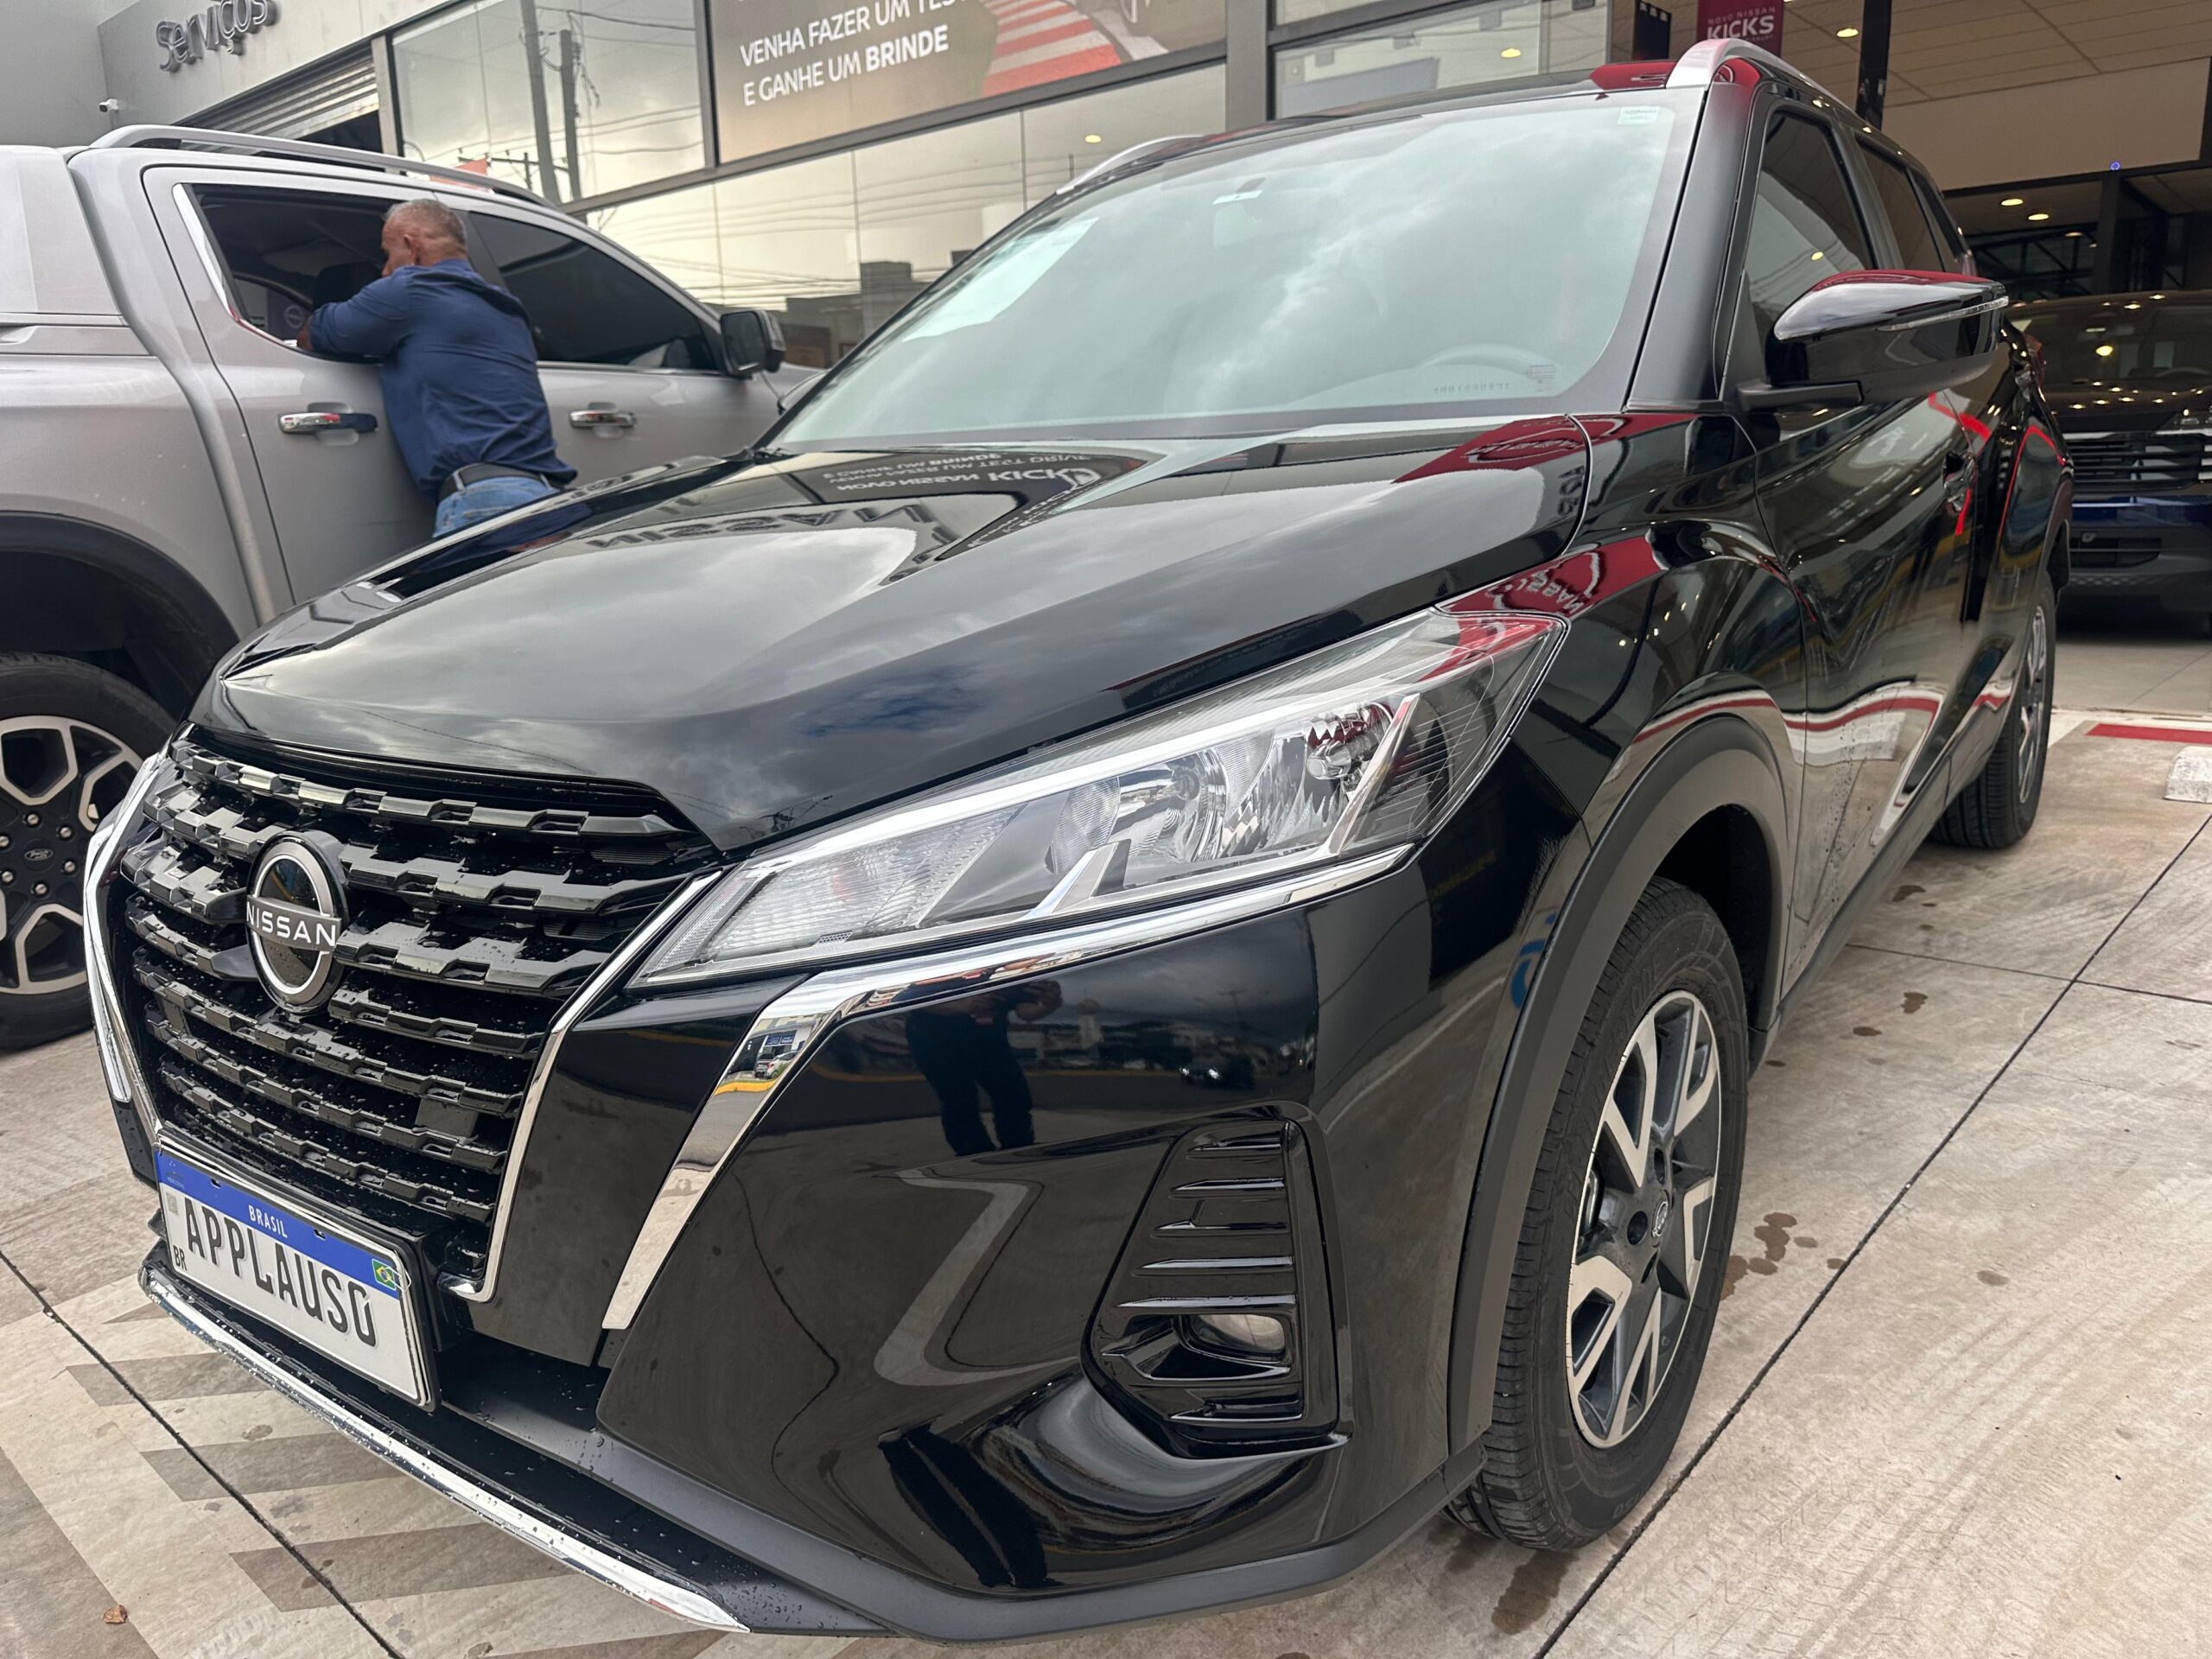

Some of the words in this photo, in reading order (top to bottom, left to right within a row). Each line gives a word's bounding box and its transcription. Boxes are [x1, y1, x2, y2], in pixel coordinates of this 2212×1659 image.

[740, 27, 805, 67] VENHA
[808, 6, 871, 47] FAZER
[874, 0, 911, 26] UM
[1707, 14, 1733, 24] NOVO
[1736, 6, 1776, 18] NISSAN
[1707, 15, 1775, 39] KICKS
[156, 0, 276, 72] Serviços
[743, 81, 756, 106] E
[759, 61, 824, 101] GANHE
[828, 51, 861, 82] UM
[865, 24, 949, 73] BRINDE
[246, 901, 336, 946] NISSAN
[248, 1205, 288, 1238] BRASIL
[173, 1244, 188, 1271] BR
